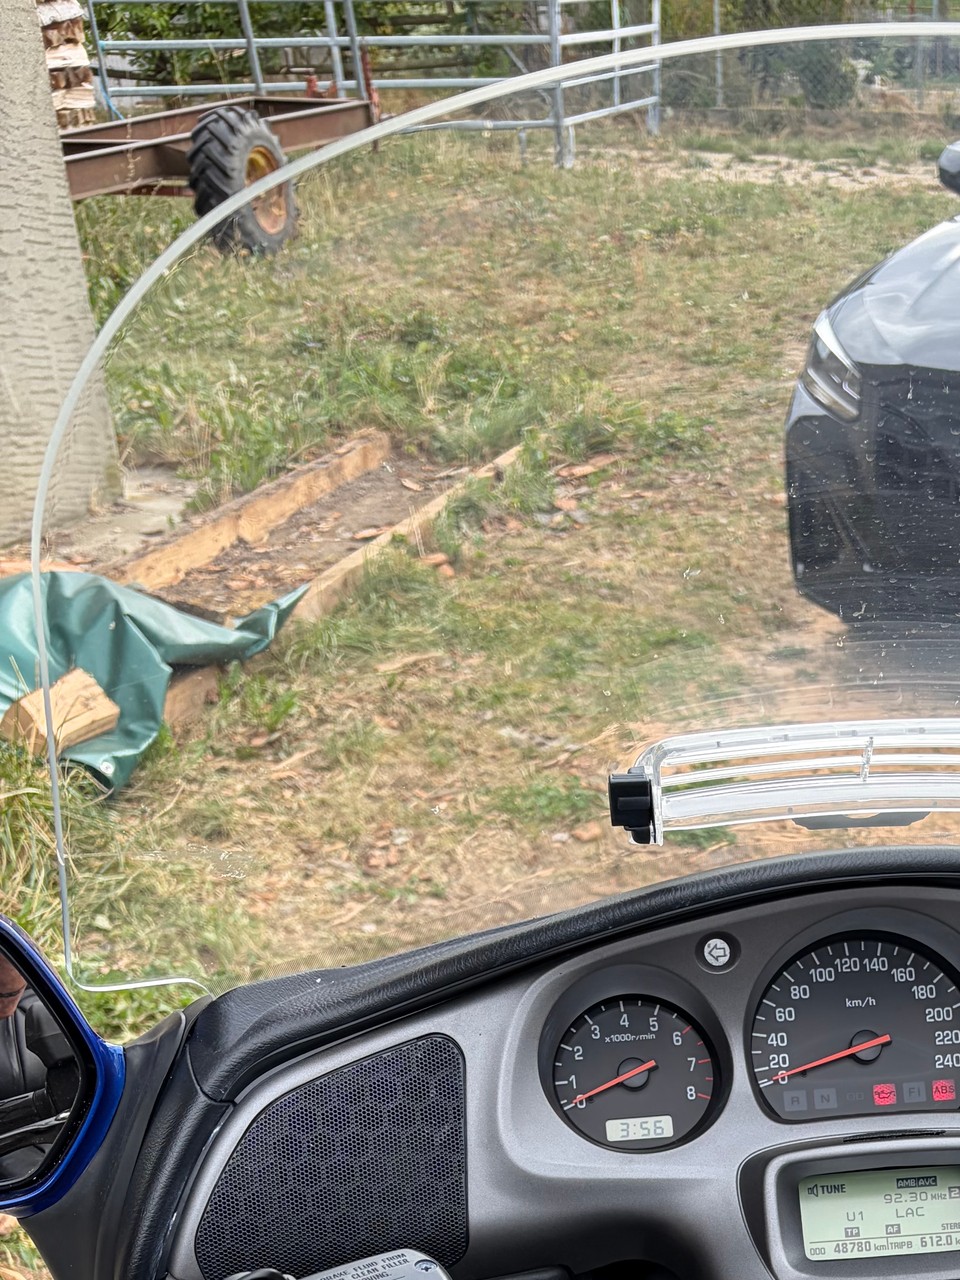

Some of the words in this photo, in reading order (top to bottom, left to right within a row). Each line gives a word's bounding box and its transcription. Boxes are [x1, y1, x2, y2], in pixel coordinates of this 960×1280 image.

[835, 958, 859, 972] 120
[863, 957, 888, 971] 140
[809, 968, 835, 982] 100
[891, 968, 915, 982] 160
[791, 985, 809, 999] 80
[912, 985, 936, 999] 180
[846, 997, 876, 1007] km/h
[620, 1014, 629, 1027] 4
[776, 1007, 795, 1021] 60
[926, 1007, 952, 1022] 200
[649, 1018, 658, 1031] 5
[591, 1026, 600, 1039] 3
[673, 1032, 682, 1045] 6
[935, 1030, 960, 1044] 220
[768, 1033, 787, 1046] 40
[574, 1047, 583, 1060] 2
[687, 1058, 695, 1071] 7
[769, 1054, 789, 1068] 20
[569, 1076, 577, 1088] 1
[687, 1087, 695, 1100] 8
[934, 1085, 954, 1094] ABS
[620, 1120, 664, 1138] 3:56
[820, 1184, 846, 1194] TUNE
[884, 1192, 928, 1204] 92.30
[896, 1207, 925, 1218] LAC
[834, 1241, 872, 1254] 48780
[873, 1243, 887, 1251] km
[920, 1235, 953, 1248] 612.0
